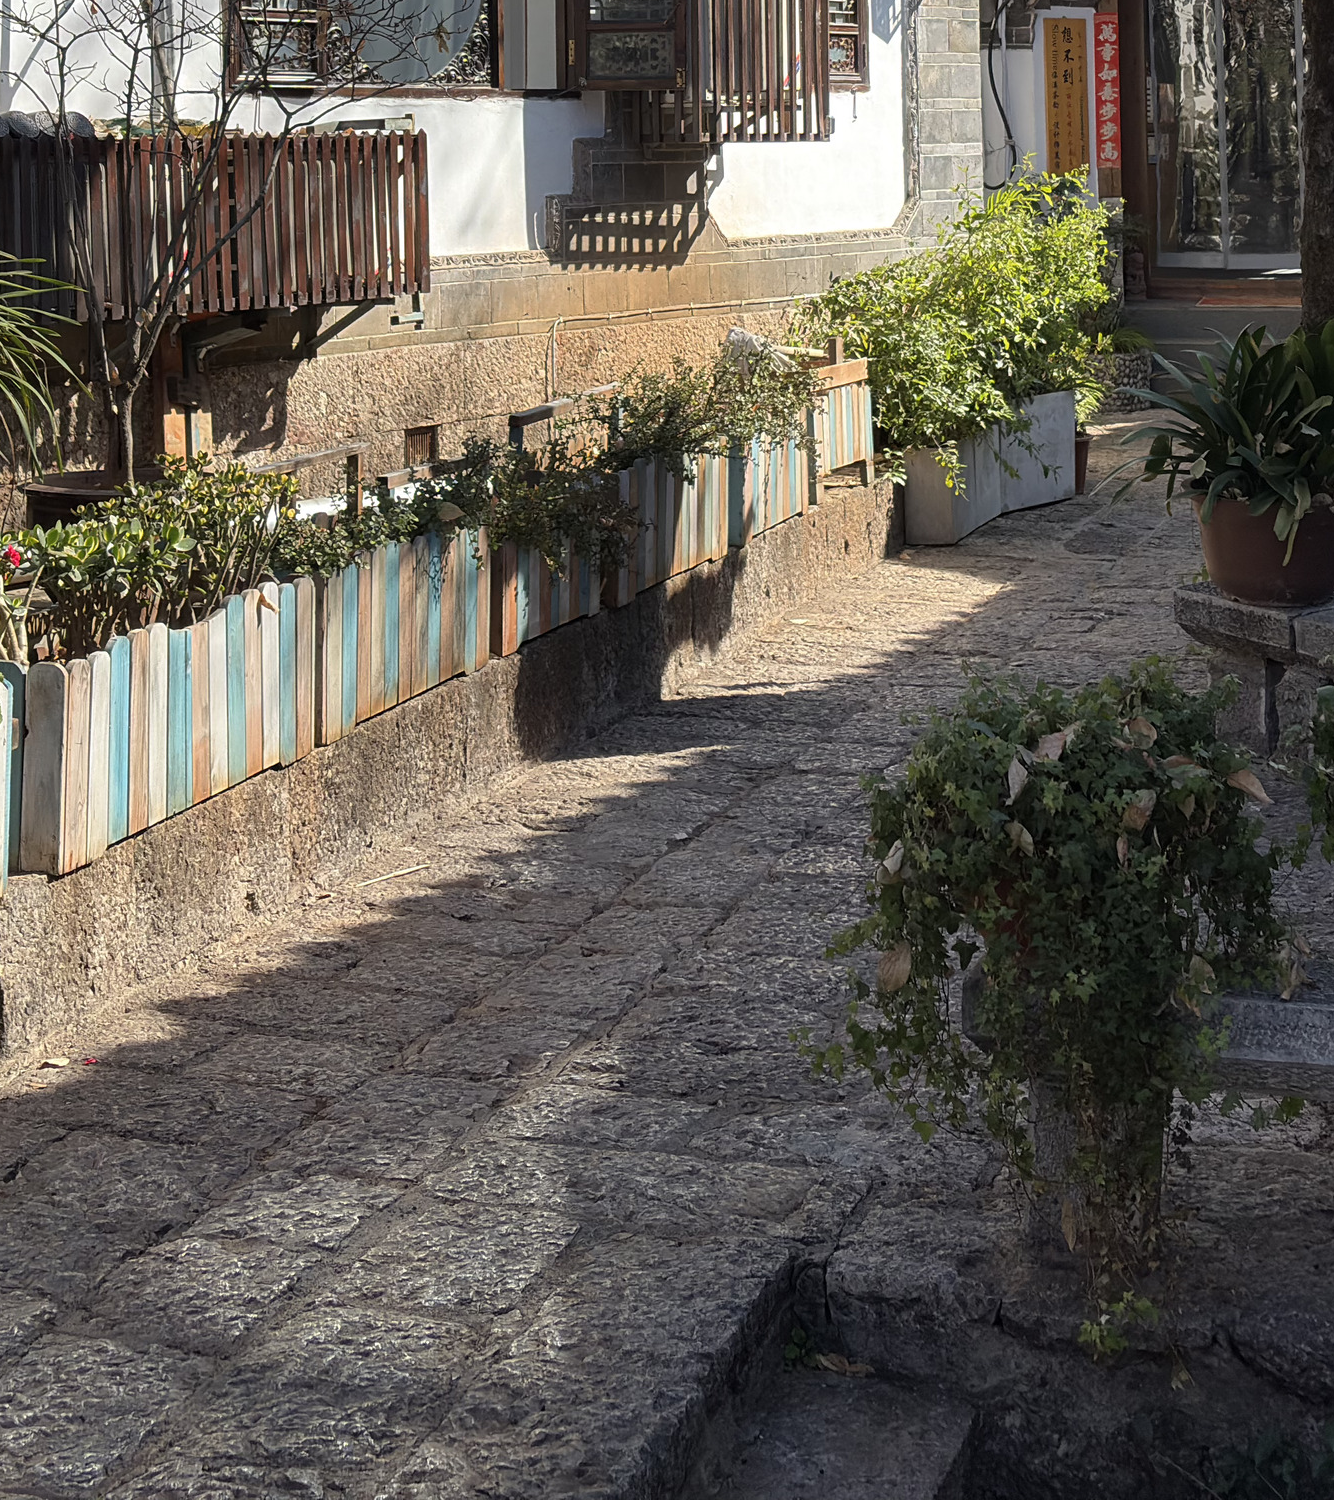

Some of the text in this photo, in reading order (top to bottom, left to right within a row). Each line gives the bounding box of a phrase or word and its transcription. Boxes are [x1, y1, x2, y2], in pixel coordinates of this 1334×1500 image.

[1061, 26, 1075, 85] 想不到
[1097, 23, 1119, 160] 萬事如意步步高
